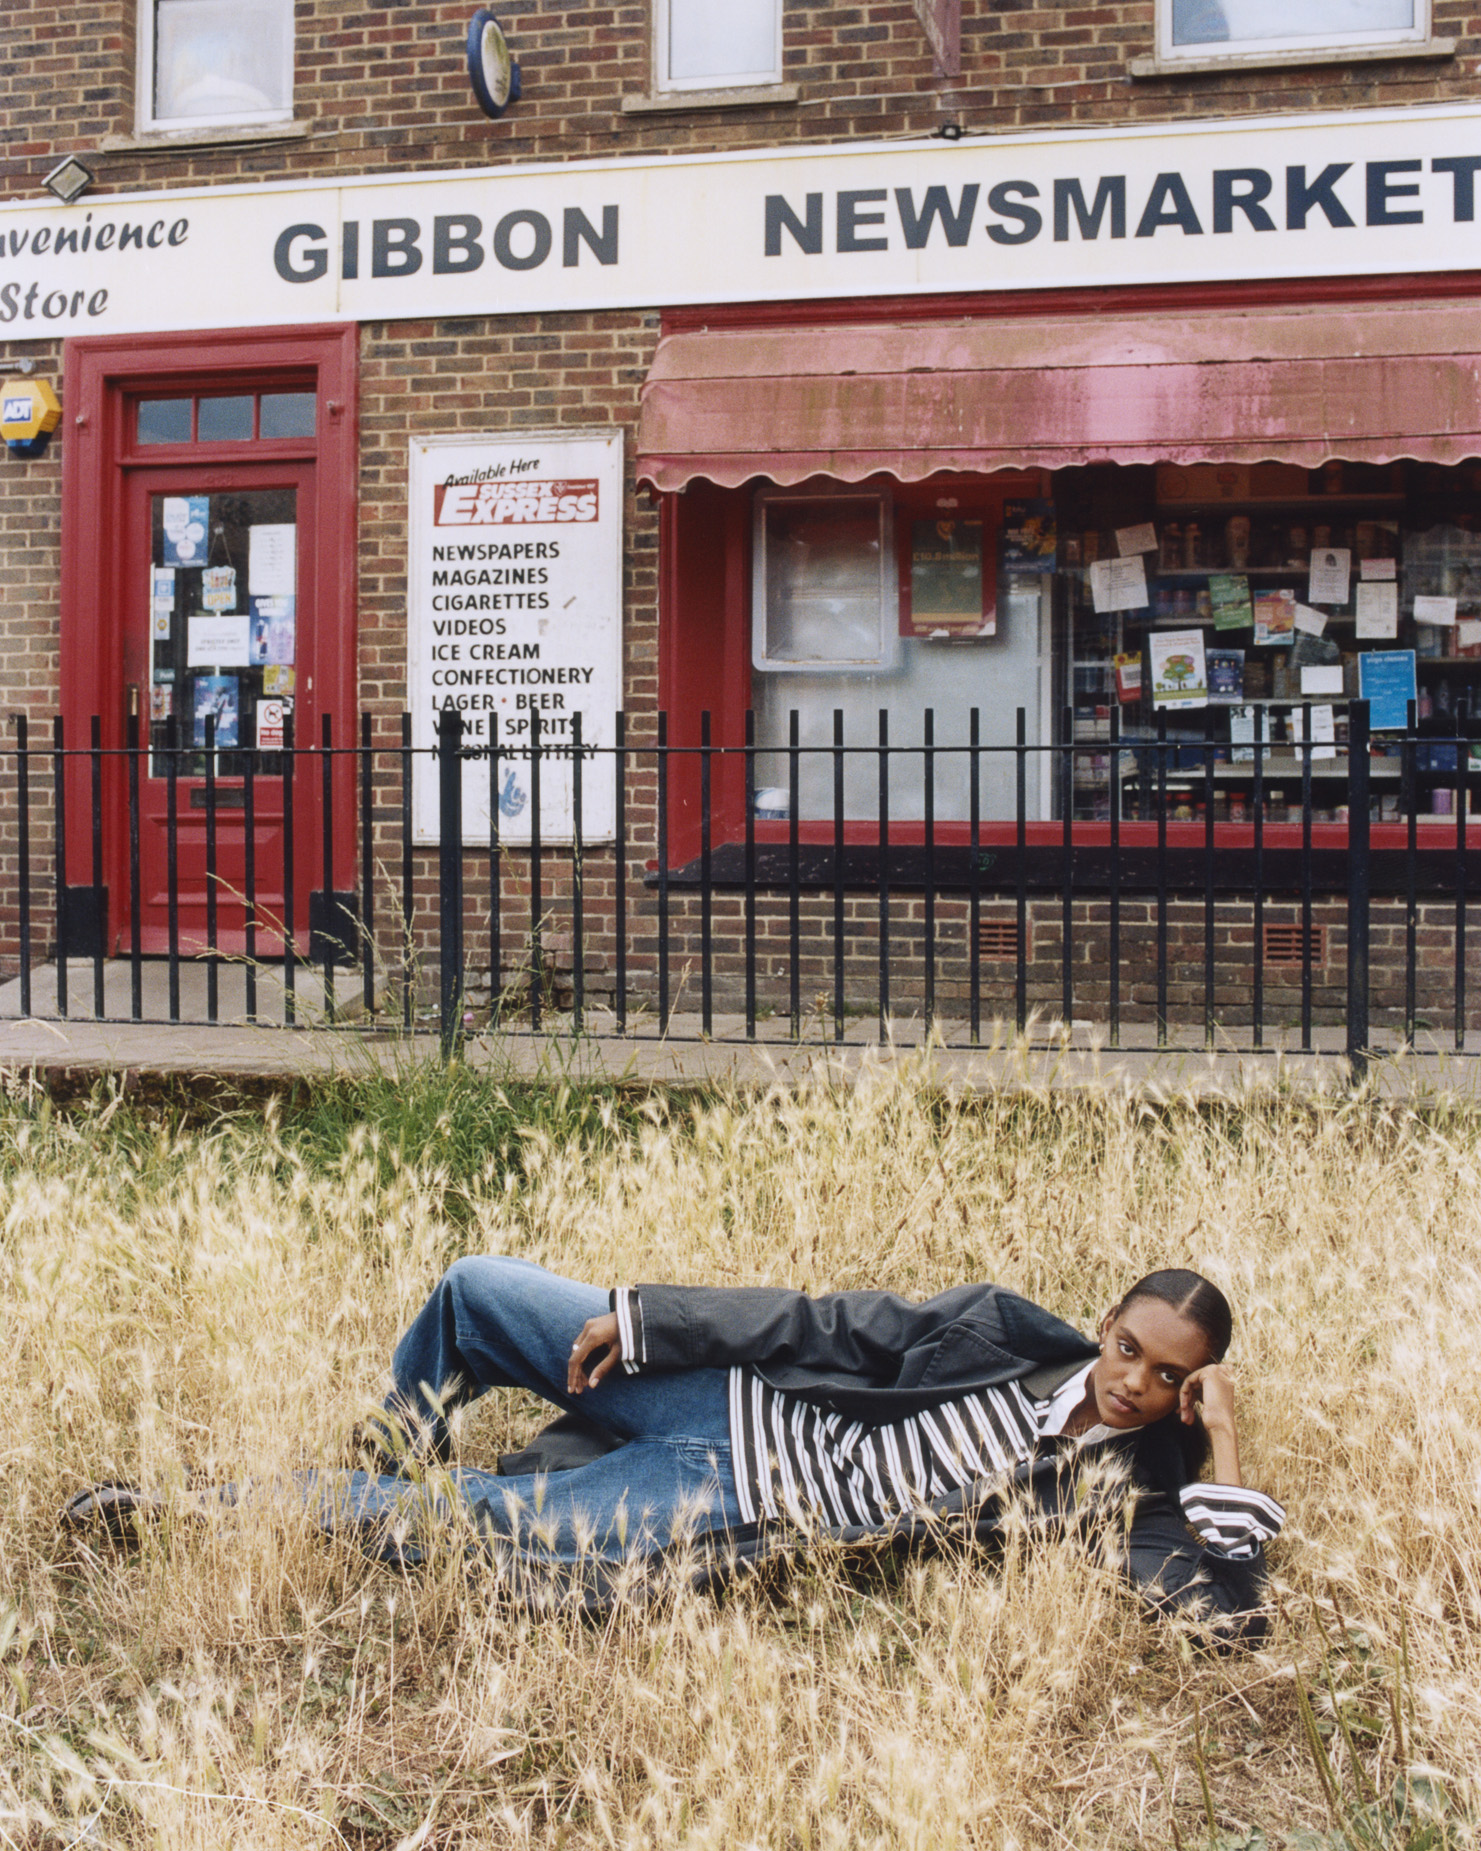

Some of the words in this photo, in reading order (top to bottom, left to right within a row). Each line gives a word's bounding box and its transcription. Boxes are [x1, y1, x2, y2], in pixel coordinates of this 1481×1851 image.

[273, 204, 619, 284] GIBBON
[764, 155, 1481, 257] NEWSMARKET
[0, 282, 108, 322] Store
[3, 400, 32, 420] ADT
[442, 463, 506, 490] Available
[509, 458, 540, 475] Here
[479, 481, 553, 500] SUSSEX
[438, 485, 597, 524] EXPRESS
[432, 541, 560, 561] NEWSPAPERS
[432, 568, 548, 586] MAGAZINES
[432, 592, 549, 611] CIGARETTES
[433, 618, 506, 636] VIDEOS
[432, 644, 460, 661] ICE
[470, 643, 540, 660] CREAM
[432, 667, 594, 686] CONFECTIONERY
[432, 694, 495, 711] LAGER
[516, 693, 565, 710] BEER
[432, 719, 484, 736] NE
[505, 718, 576, 735] SPRIT
